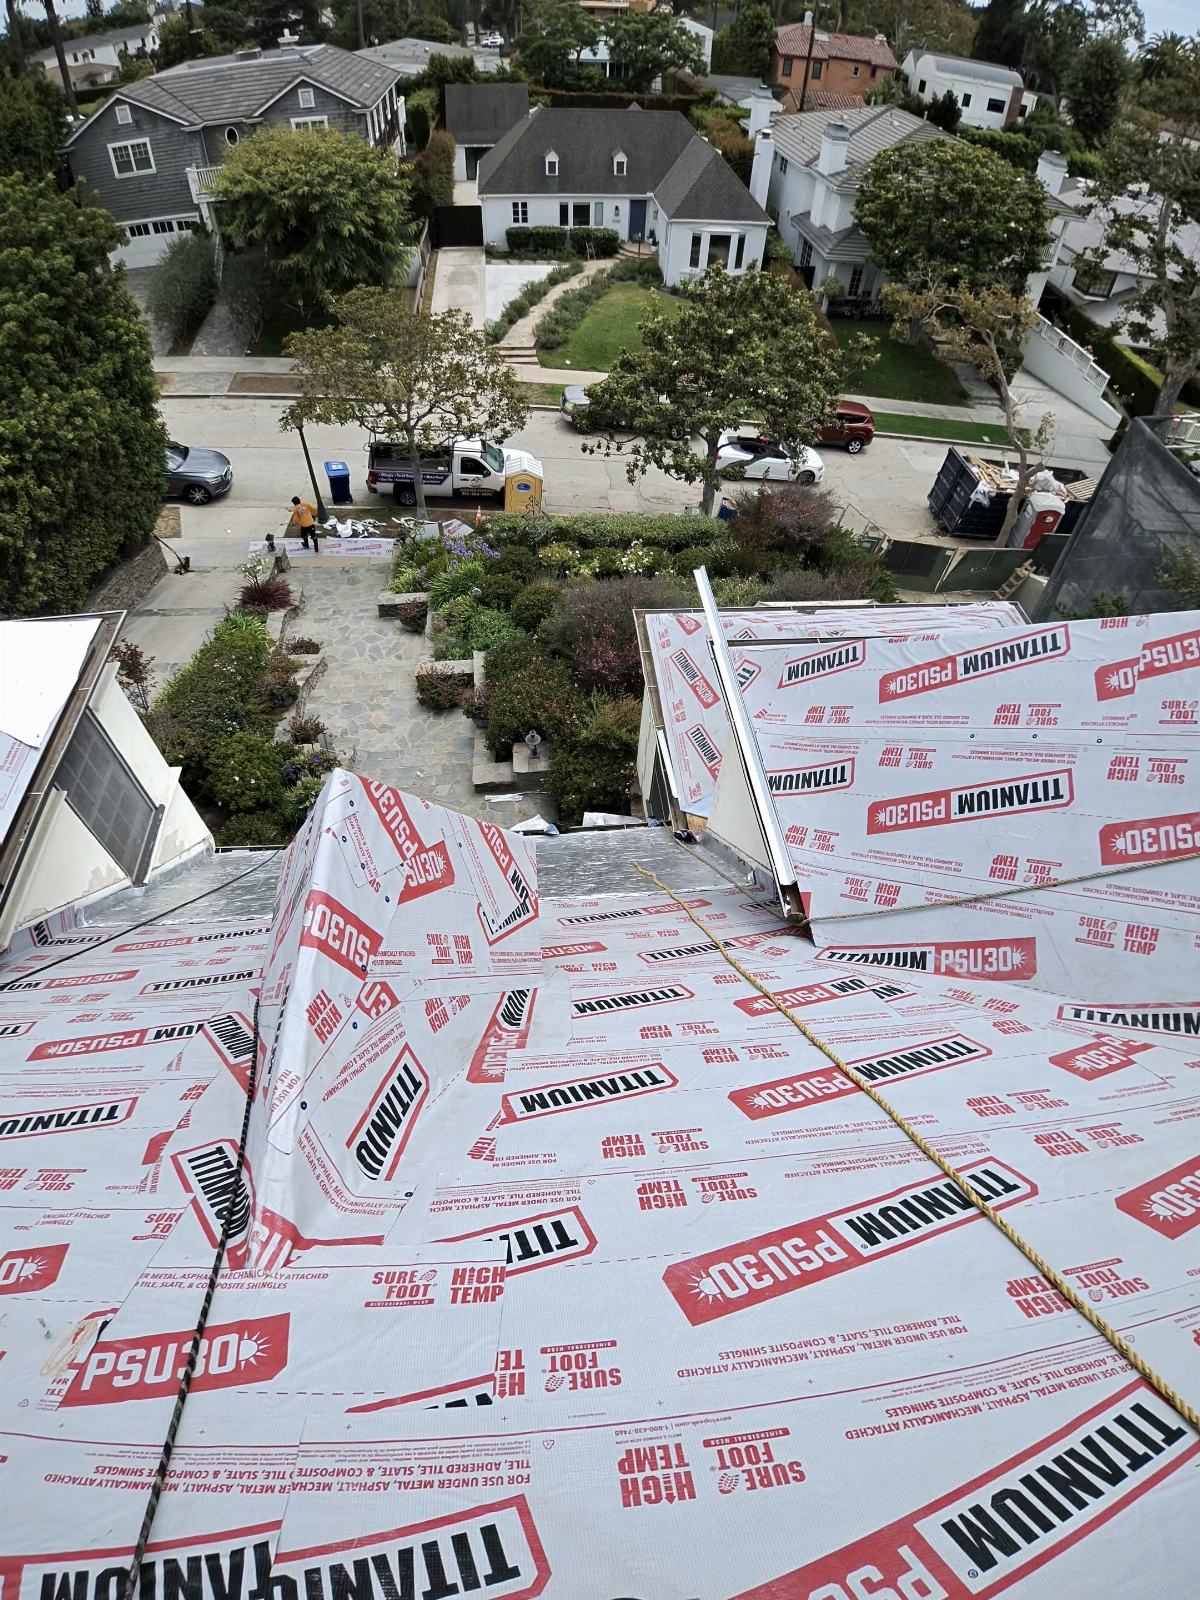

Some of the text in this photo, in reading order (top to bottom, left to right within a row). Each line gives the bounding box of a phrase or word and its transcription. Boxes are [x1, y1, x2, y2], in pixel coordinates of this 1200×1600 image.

[1140, 636, 1200, 671] PSU3
[787, 645, 859, 681] TITANIUM
[896, 632, 1062, 694] TITANIUM PSU30
[997, 704, 1021, 713] TEMP
[1161, 701, 1187, 709] SURE
[994, 715, 1020, 725] HIGH
[1034, 717, 1058, 725] SURE
[882, 747, 903, 757] TEMP
[879, 755, 901, 767] HIGH
[1110, 756, 1139, 767] TEMP
[1150, 764, 1175, 773] FOOT
[768, 765, 847, 791] TITANIUM
[1107, 768, 1138, 781] HIGH
[1158, 774, 1184, 784] SURE
[885, 778, 1063, 826] TITANIUM PSU30
[992, 855, 1018, 868] TEMP
[989, 867, 1017, 881] HIGH
[844, 877, 866, 888] SURE
[875, 883, 901, 896] HIGH
[849, 887, 868, 896] FOOT
[874, 894, 898, 907] TEMP
[566, 908, 642, 925] TITANIUM
[1079, 917, 1105, 930] SURE
[1087, 929, 1112, 942] FOOT
[1124, 924, 1160, 942] HIGH
[1123, 939, 1157, 955] TEMP
[827, 946, 1013, 974] TITANIUM PSU30
[51, 973, 118, 988] PSU30
[152, 971, 255, 991] TITANIUM
[305, 989, 333, 1026] TEMP
[574, 988, 685, 1014] TITANIUM
[314, 1003, 344, 1045] HIGH
[1071, 1007, 1200, 1035] TITANIUM
[56, 1032, 140, 1054] PSU30
[640, 1031, 673, 1040] HIGH
[704, 1055, 739, 1064] HIGH
[757, 1040, 980, 1107] TITANIUM PSU30
[521, 1068, 666, 1112] TITANIUM
[966, 1095, 1004, 1107] TEMP
[972, 1103, 1016, 1118] HIGH
[356, 1063, 423, 1181] TITANIU
[601, 1134, 644, 1146] TEMP
[658, 1133, 692, 1145] FOOT
[1033, 1130, 1076, 1145] TEMP
[602, 1144, 646, 1159] HIGH
[674, 1140, 710, 1153] SURE
[1042, 1141, 1090, 1157] HIGH
[33, 1173, 70, 1182] FOOT
[700, 1179, 738, 1192] FOOT
[39, 1182, 75, 1191] SURE
[637, 1179, 684, 1195] TEMP
[639, 1192, 688, 1210] HIGH
[718, 1188, 758, 1202] SURE
[709, 1168, 1022, 1299] TITANIUM PSU30
[285, 1273, 329, 1281] ATTACHED
[372, 1270, 418, 1285] SURE
[451, 1266, 506, 1286] HIGH
[1075, 1268, 1122, 1289] FOOT
[246, 1282, 288, 1290] SHINGLES
[386, 1284, 431, 1299] FOOT
[1102, 1277, 1150, 1298] SURE
[450, 1285, 504, 1304] TEMP
[718, 1315, 961, 1361] TILE, ADHERED SLATE, COMPOSITE SHINGLES
[677, 1325, 967, 1378] FOR USE UNDER METAL, ASPHALT, MECHANICALLY ATTACHED
[81, 1333, 240, 1392] PSU30
[548, 1351, 598, 1373] FOOT
[568, 1368, 622, 1390] SURE
[885, 1358, 1108, 1419] ADHERED TILE, COMPOSITE SHINGLES
[845, 1368, 1119, 1441] USE UNDER METAL, ASPHALT, MECHANICALLY ATTACHED
[617, 1442, 690, 1475] TEMP
[717, 1442, 775, 1471] FOOT
[94, 1465, 259, 1480] SLATE, SHINGLES
[296, 1459, 531, 1478] TILE, ADHERED TILE, SLATE, COMPOSITE
[746, 1460, 806, 1491] SURE
[44, 1474, 277, 1495] METAL, ASPHALT, ATTACHED
[337, 1474, 530, 1493] FOR USE UNDER METAL, ASPHALT,
[620, 1470, 696, 1508] HIGH
[941, 1402, 1187, 1572] TITANIUM
